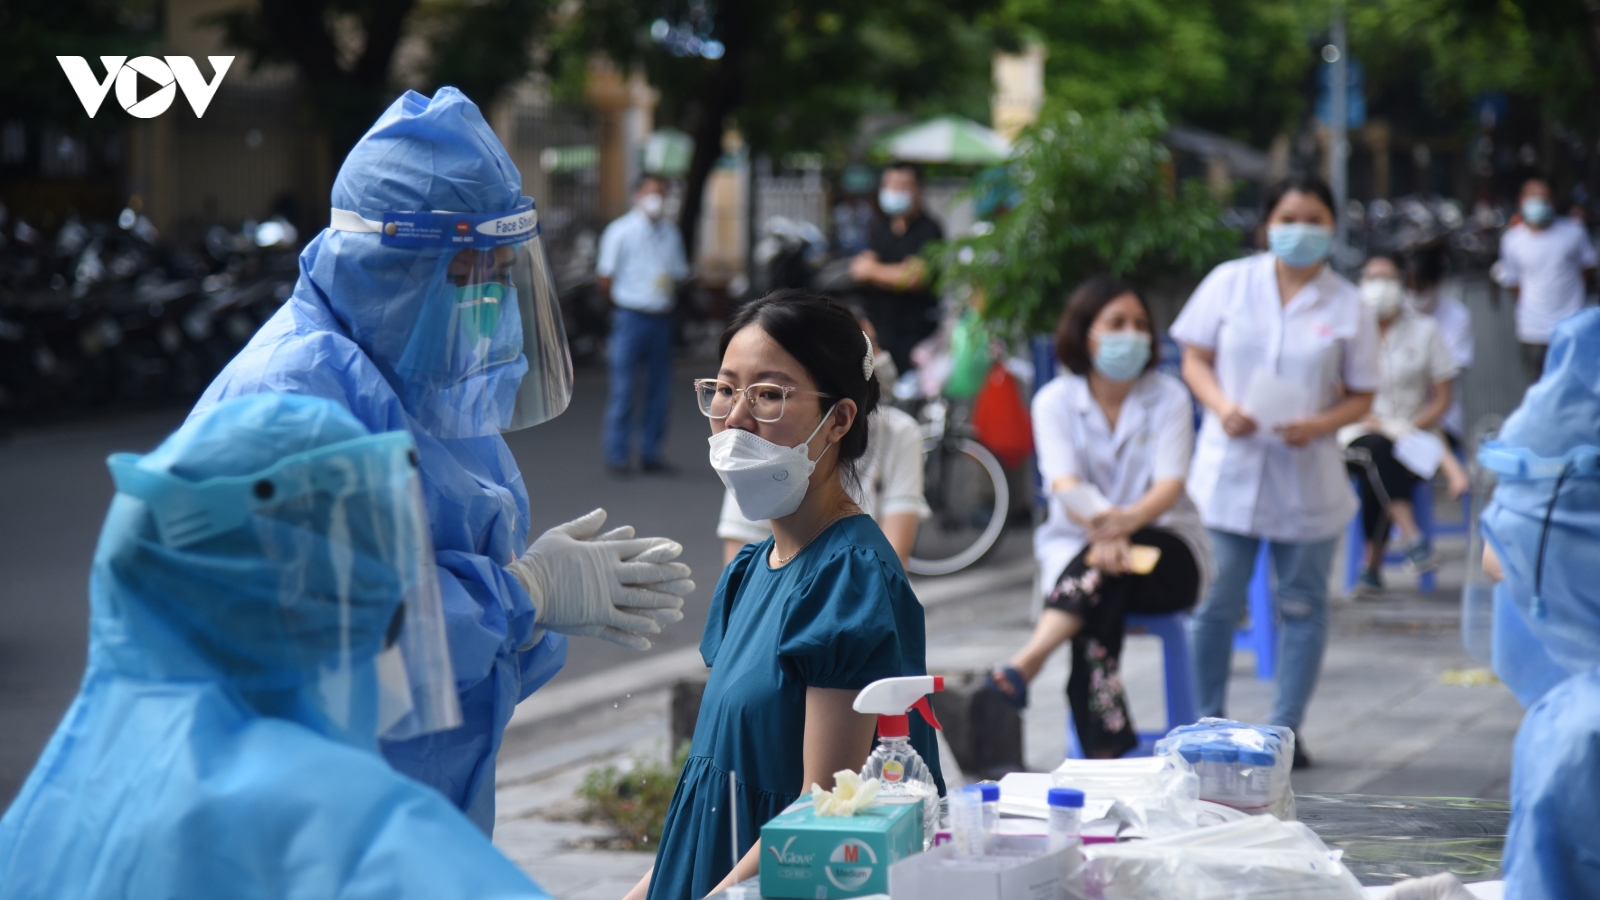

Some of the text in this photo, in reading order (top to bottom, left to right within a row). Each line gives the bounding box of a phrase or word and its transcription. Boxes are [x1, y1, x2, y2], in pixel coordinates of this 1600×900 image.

[496, 220, 517, 234] Face
[844, 845, 859, 863] M
[836, 868, 868, 879] Medium
